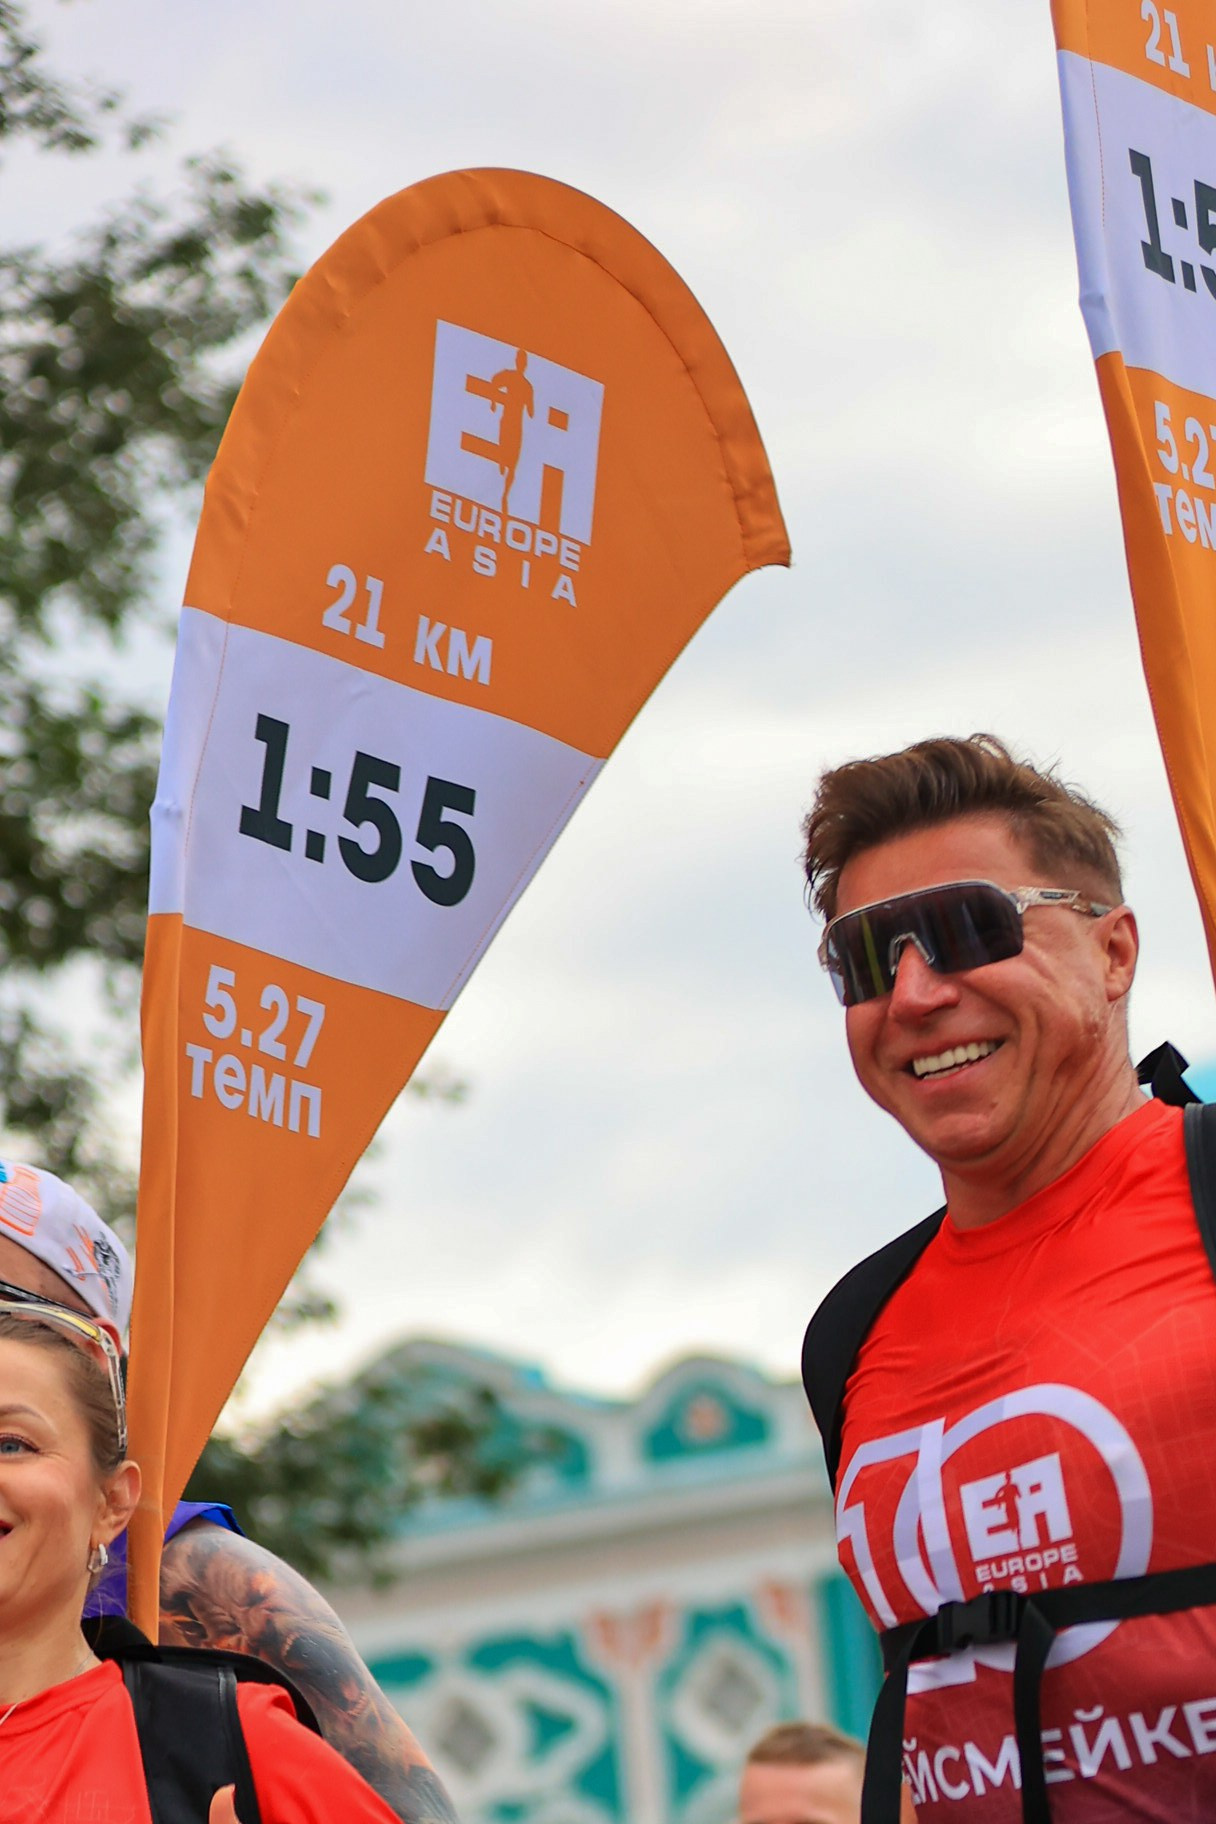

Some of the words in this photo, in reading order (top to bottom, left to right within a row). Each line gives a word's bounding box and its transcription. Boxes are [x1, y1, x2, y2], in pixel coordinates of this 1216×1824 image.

[1141, 0, 1190, 79] 21
[424, 527, 578, 608] ASIA
[430, 490, 581, 572] EUROPE
[322, 563, 386, 650] 21
[239, 712, 477, 907] 1:55
[202, 964, 326, 1068] 5.27
[185, 1042, 322, 1139] темп
[975, 1543, 1079, 1583] EUROPE
